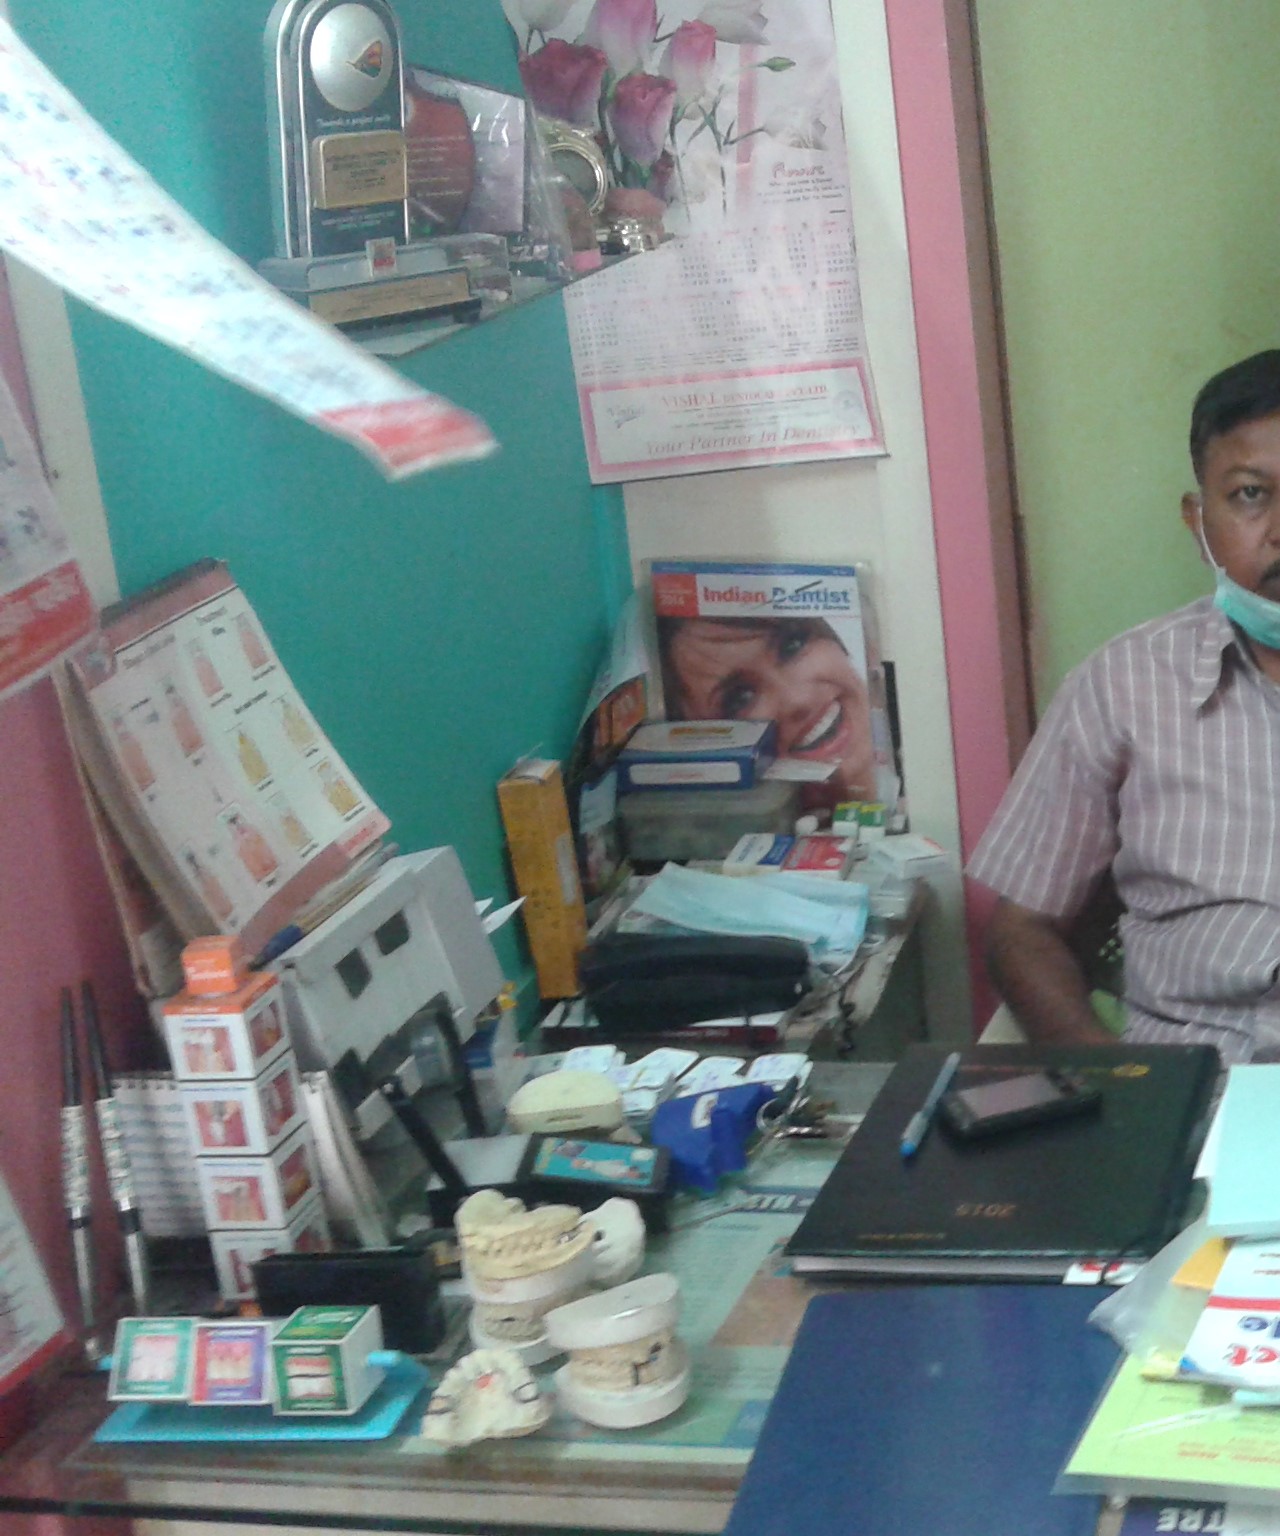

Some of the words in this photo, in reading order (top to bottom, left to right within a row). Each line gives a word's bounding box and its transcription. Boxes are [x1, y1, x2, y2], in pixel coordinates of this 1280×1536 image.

[690, 432, 753, 450] Partner
[703, 585, 767, 603] Indian
[772, 585, 850, 603] Dentist
